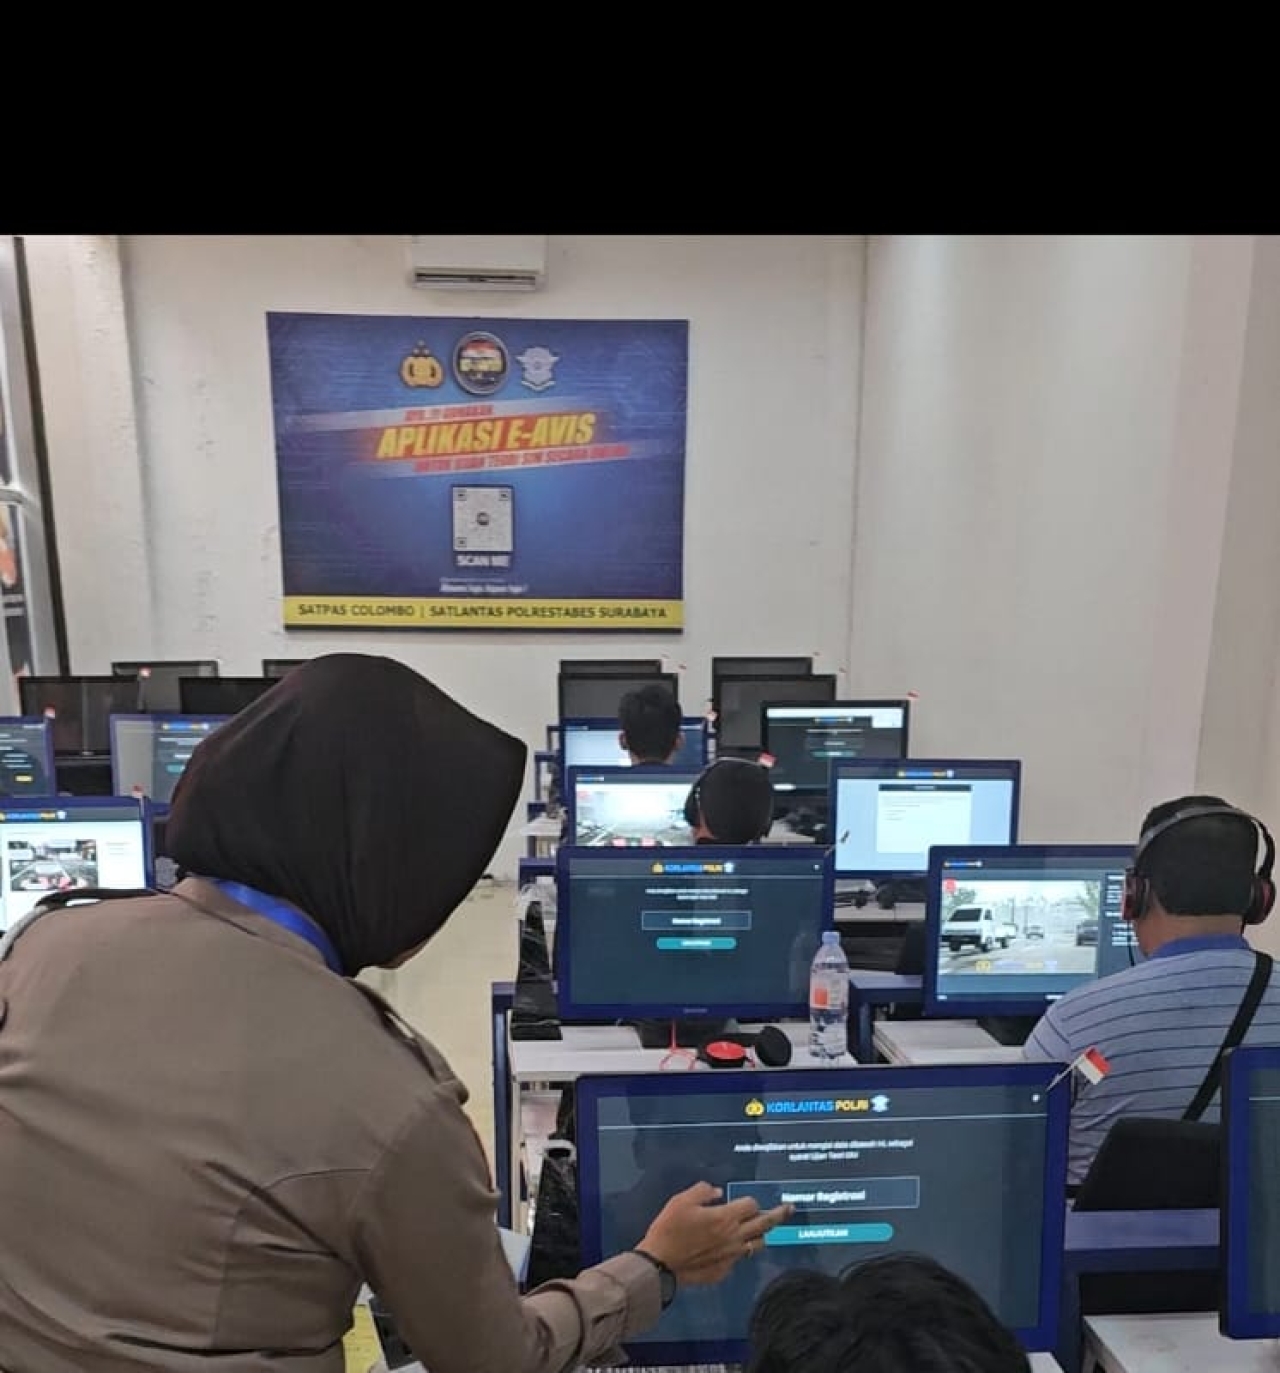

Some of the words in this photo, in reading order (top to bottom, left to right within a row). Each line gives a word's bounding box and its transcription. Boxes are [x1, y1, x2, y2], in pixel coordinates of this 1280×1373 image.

[377, 420, 505, 458] APLIKASI
[508, 413, 595, 448] E-AVIS
[457, 555, 489, 567] SCAN
[298, 604, 346, 616] SATPAS
[351, 605, 415, 617] COLOMBO
[428, 605, 503, 618] SATLANTAS
[506, 606, 596, 618] POLRESTABES
[598, 606, 668, 618] SURABAYA
[766, 1100, 834, 1113] KORLANTAS
[835, 1099, 869, 1111] POLRI
